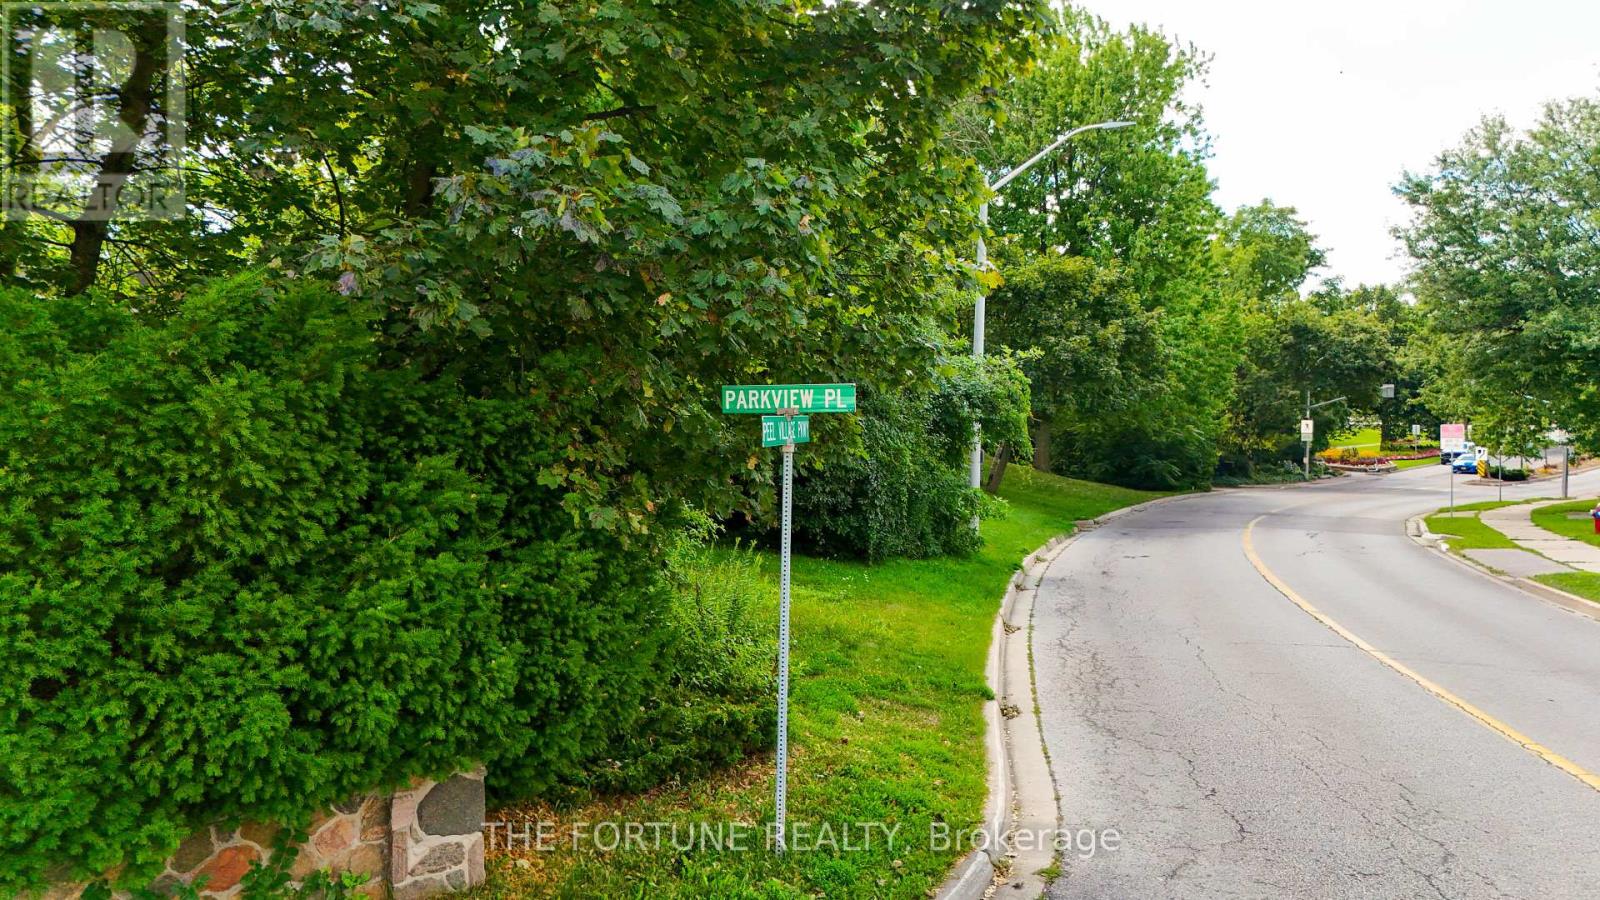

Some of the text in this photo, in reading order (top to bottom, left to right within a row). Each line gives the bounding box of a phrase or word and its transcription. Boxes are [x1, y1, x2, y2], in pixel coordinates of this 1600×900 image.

[725, 388, 847, 409] PARKVIEW PL
[762, 421, 776, 441] PEEL
